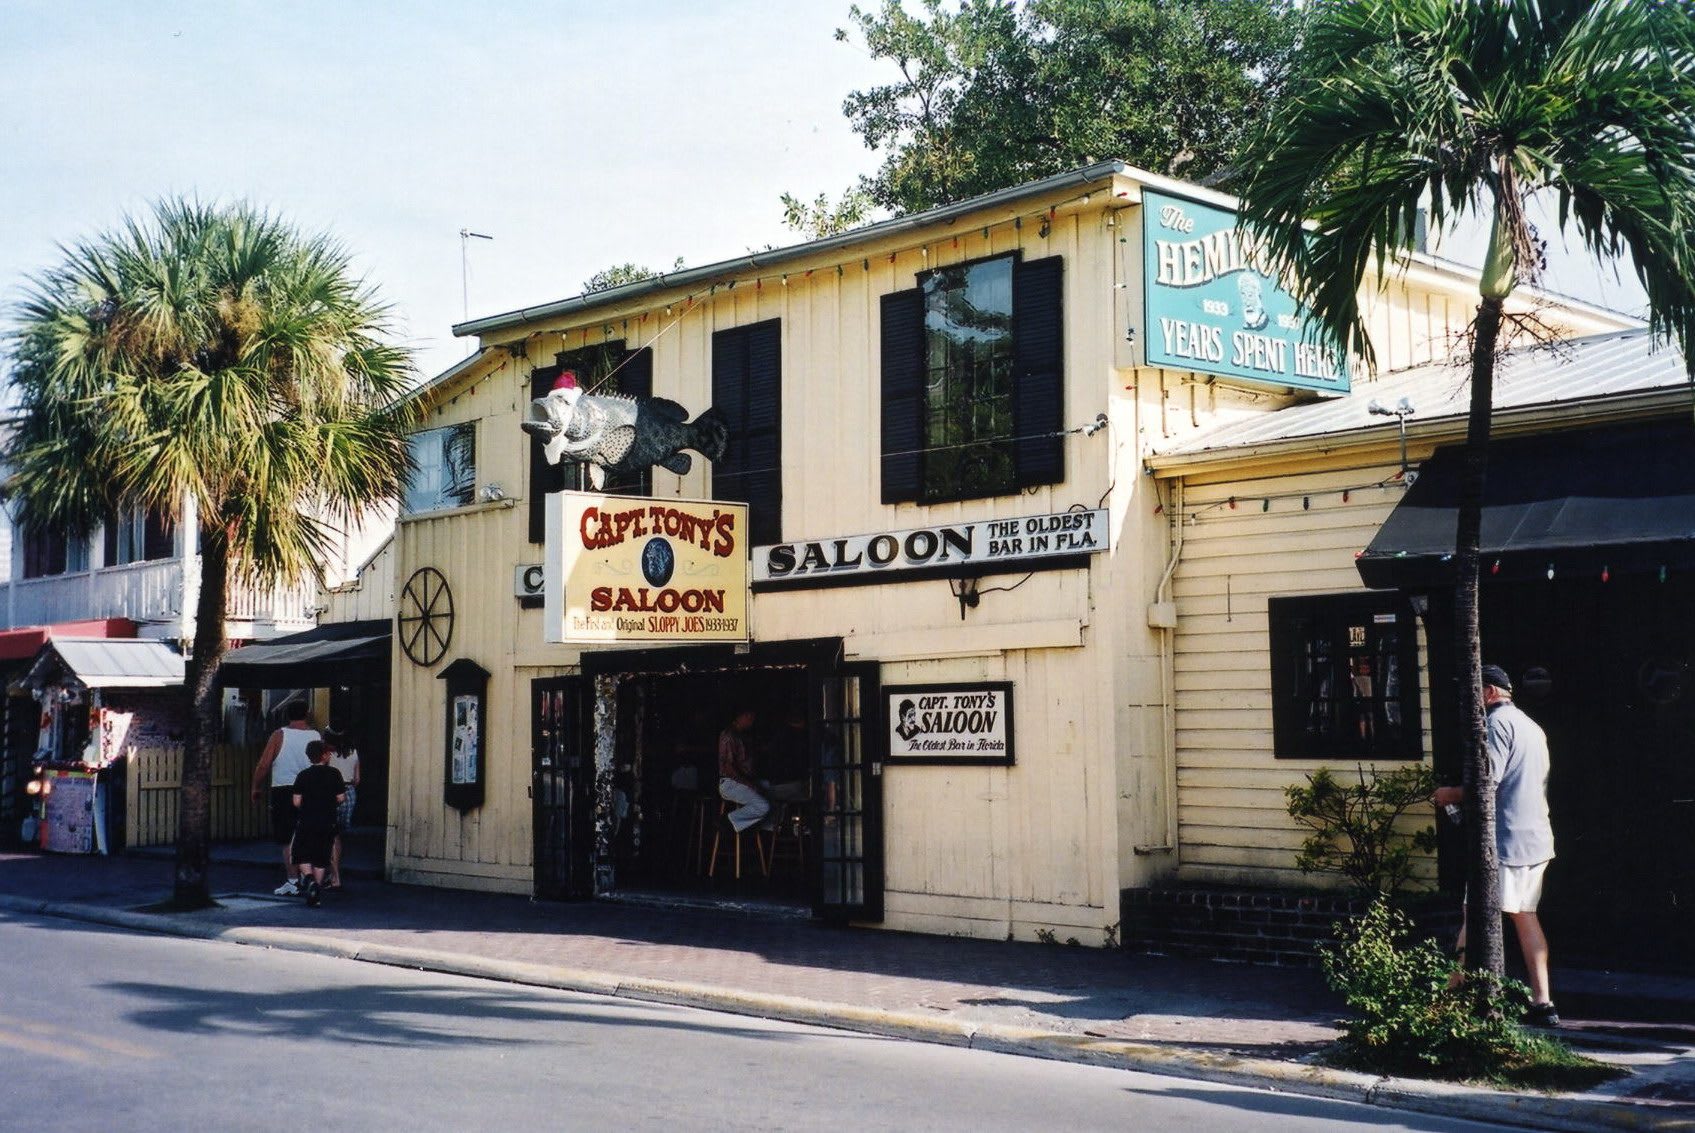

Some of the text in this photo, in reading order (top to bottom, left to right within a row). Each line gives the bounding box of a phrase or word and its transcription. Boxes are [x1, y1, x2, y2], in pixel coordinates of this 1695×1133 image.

[1160, 205, 1194, 234] The
[1160, 318, 1339, 382] YEARS SPENT HERE
[580, 507, 735, 558] CAPT. TONY'S
[988, 513, 1095, 538] THE OLDEST
[768, 526, 975, 579] SALOON
[988, 531, 1097, 556] BAR IN FLA.
[591, 586, 726, 613] SALOON
[616, 616, 646, 633] Original
[648, 616, 680, 632] SLOPPY
[681, 616, 705, 632] JOES
[919, 691, 996, 709] CAPT. TONY'S
[920, 710, 997, 734] SALOON
[908, 738, 1005, 751] The Oldest Bar in Florida
